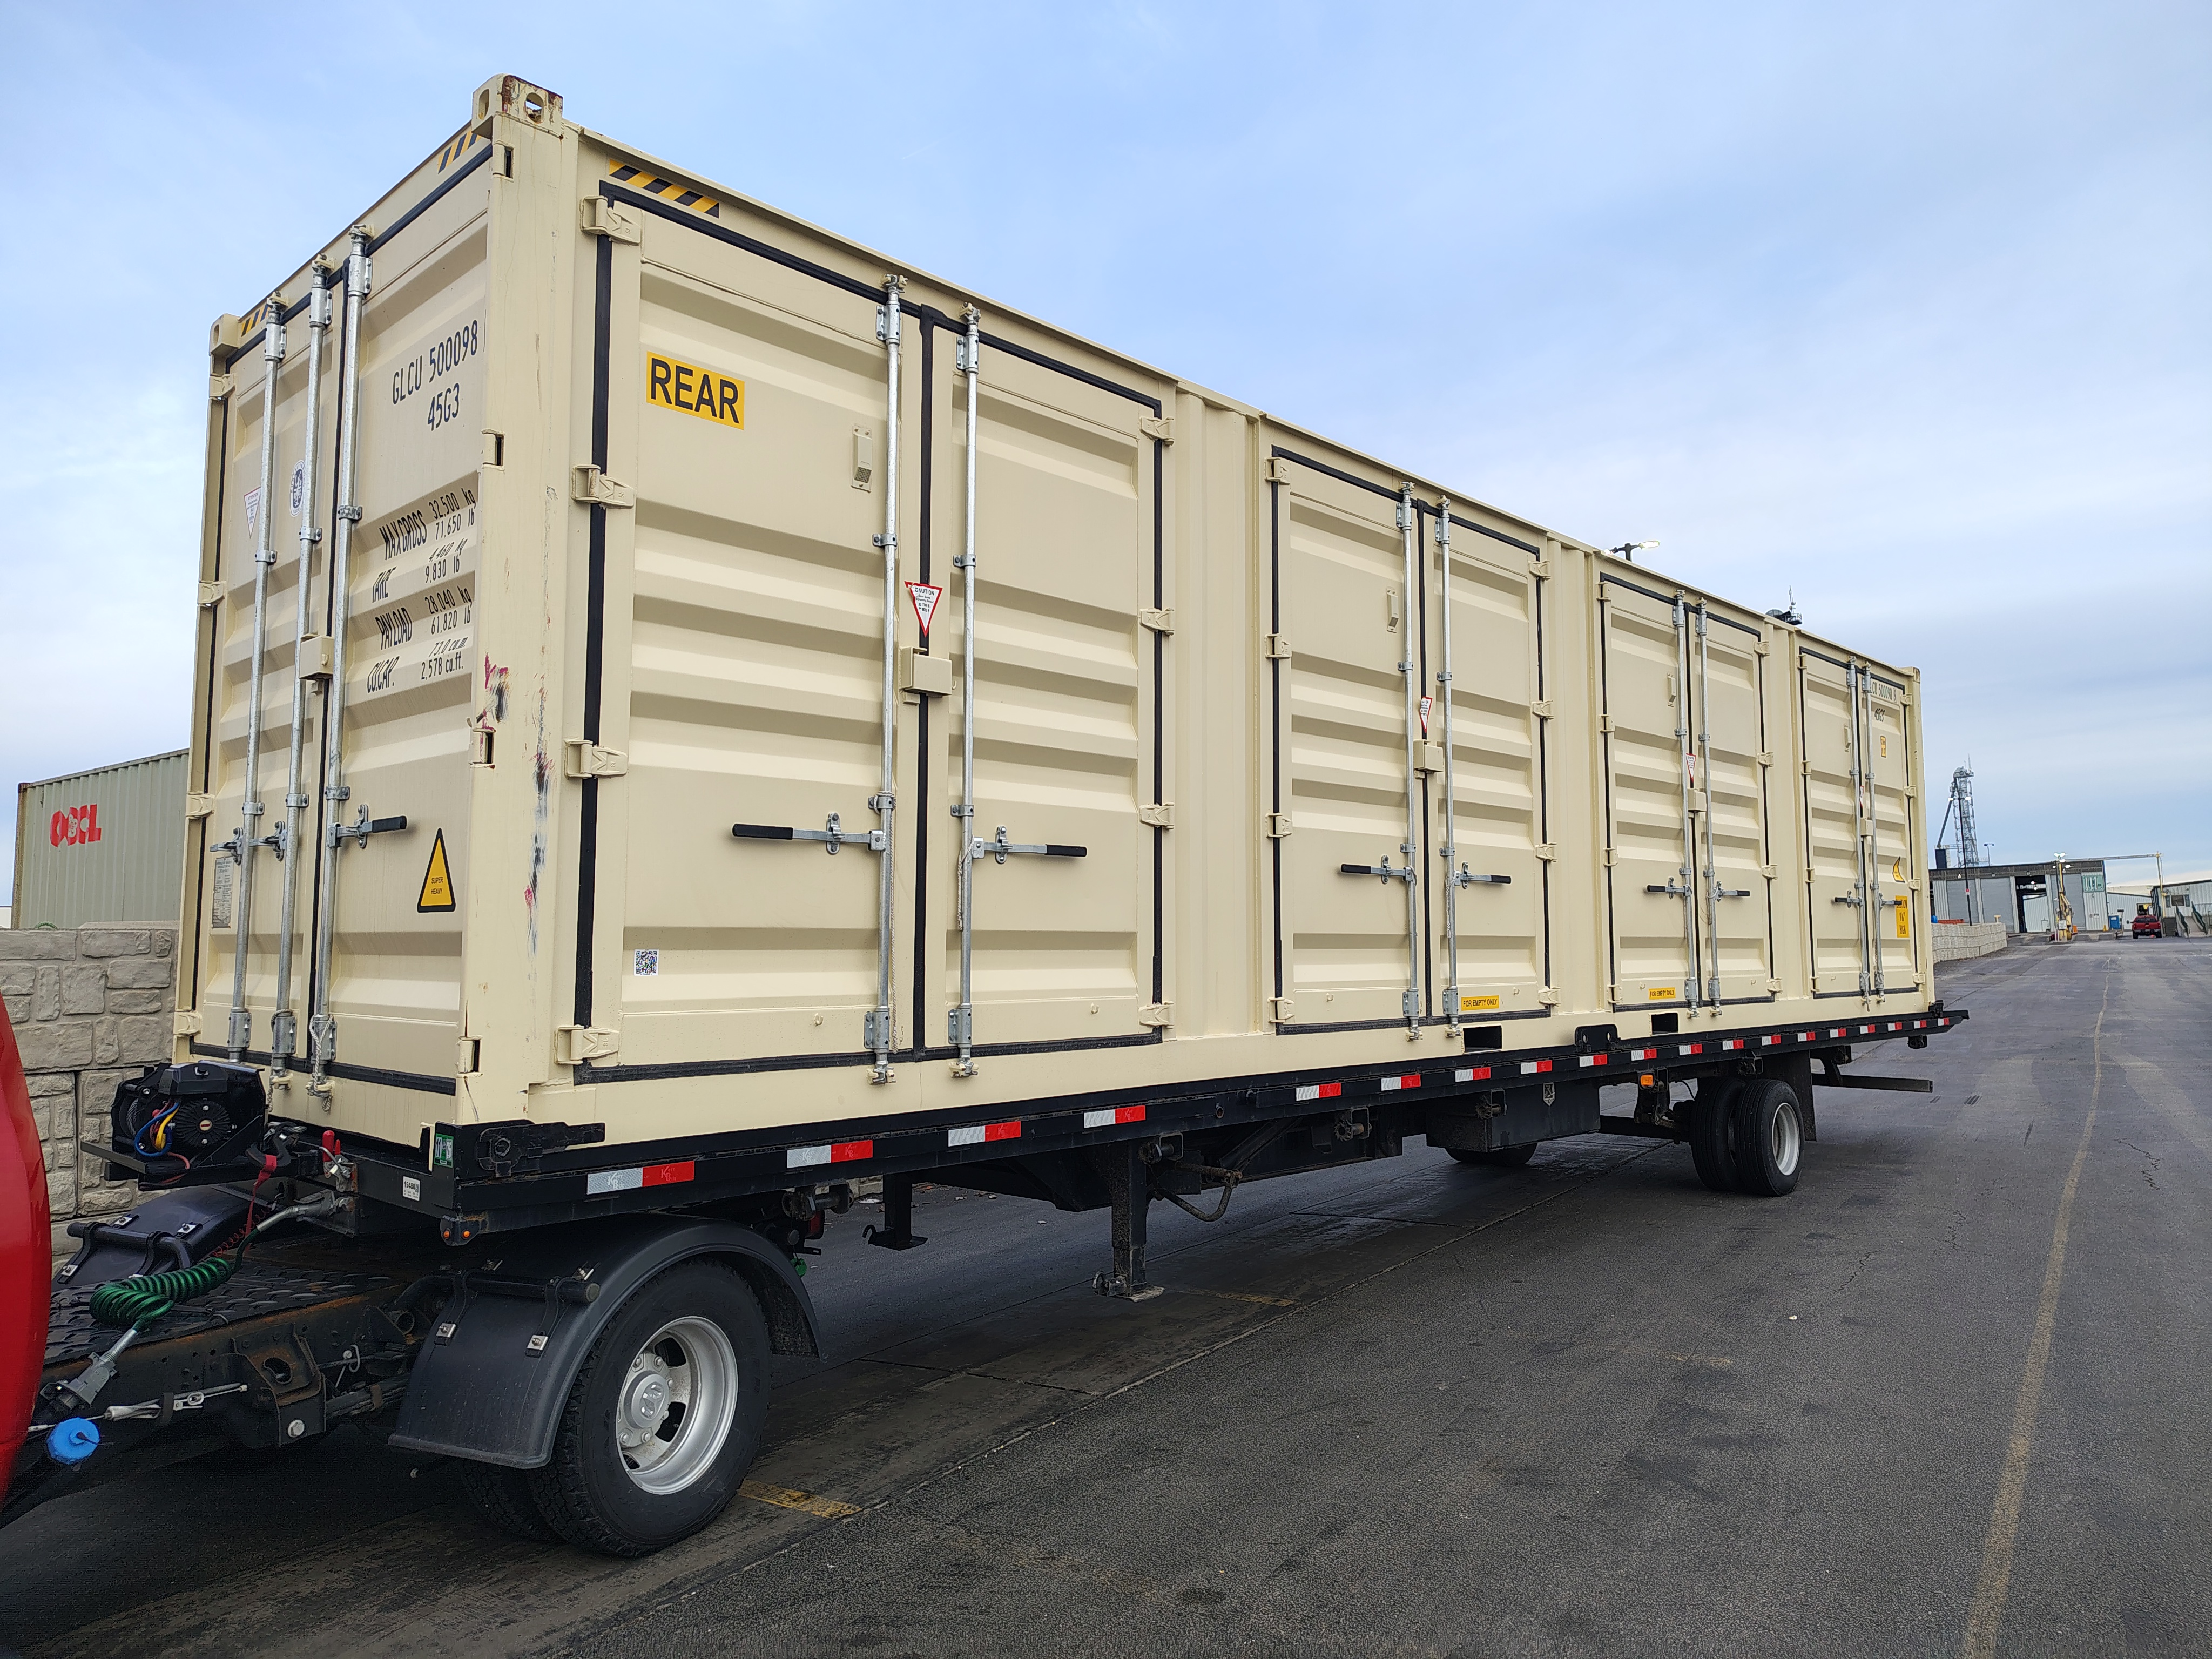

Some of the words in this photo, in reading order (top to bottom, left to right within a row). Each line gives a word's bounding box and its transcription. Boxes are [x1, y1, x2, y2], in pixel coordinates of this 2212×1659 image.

[393, 355, 422, 404] GLCU
[429, 320, 478, 383] 500098
[428, 382, 460, 431] 45G3
[651, 357, 740, 424] REAR
[379, 510, 427, 561] MAXGROSS
[429, 492, 460, 520] 32,500
[461, 487, 476, 509] kg
[435, 514, 461, 540] 71,650
[468, 508, 475, 527] lb
[372, 566, 397, 603] TARE
[455, 538, 468, 556] kg
[426, 559, 447, 584] 9,830
[453, 555, 460, 574] lb
[914, 587, 935, 596] CAUTION
[375, 607, 413, 650] PAYLOAD
[424, 589, 456, 614] 28,040
[457, 585, 472, 608] kg
[431, 610, 457, 635] 61,820
[464, 605, 471, 624] lb
[421, 657, 442, 680] 2,578
[446, 651, 463, 673] cu.ft.
[50, 804, 102, 848] OOCL
